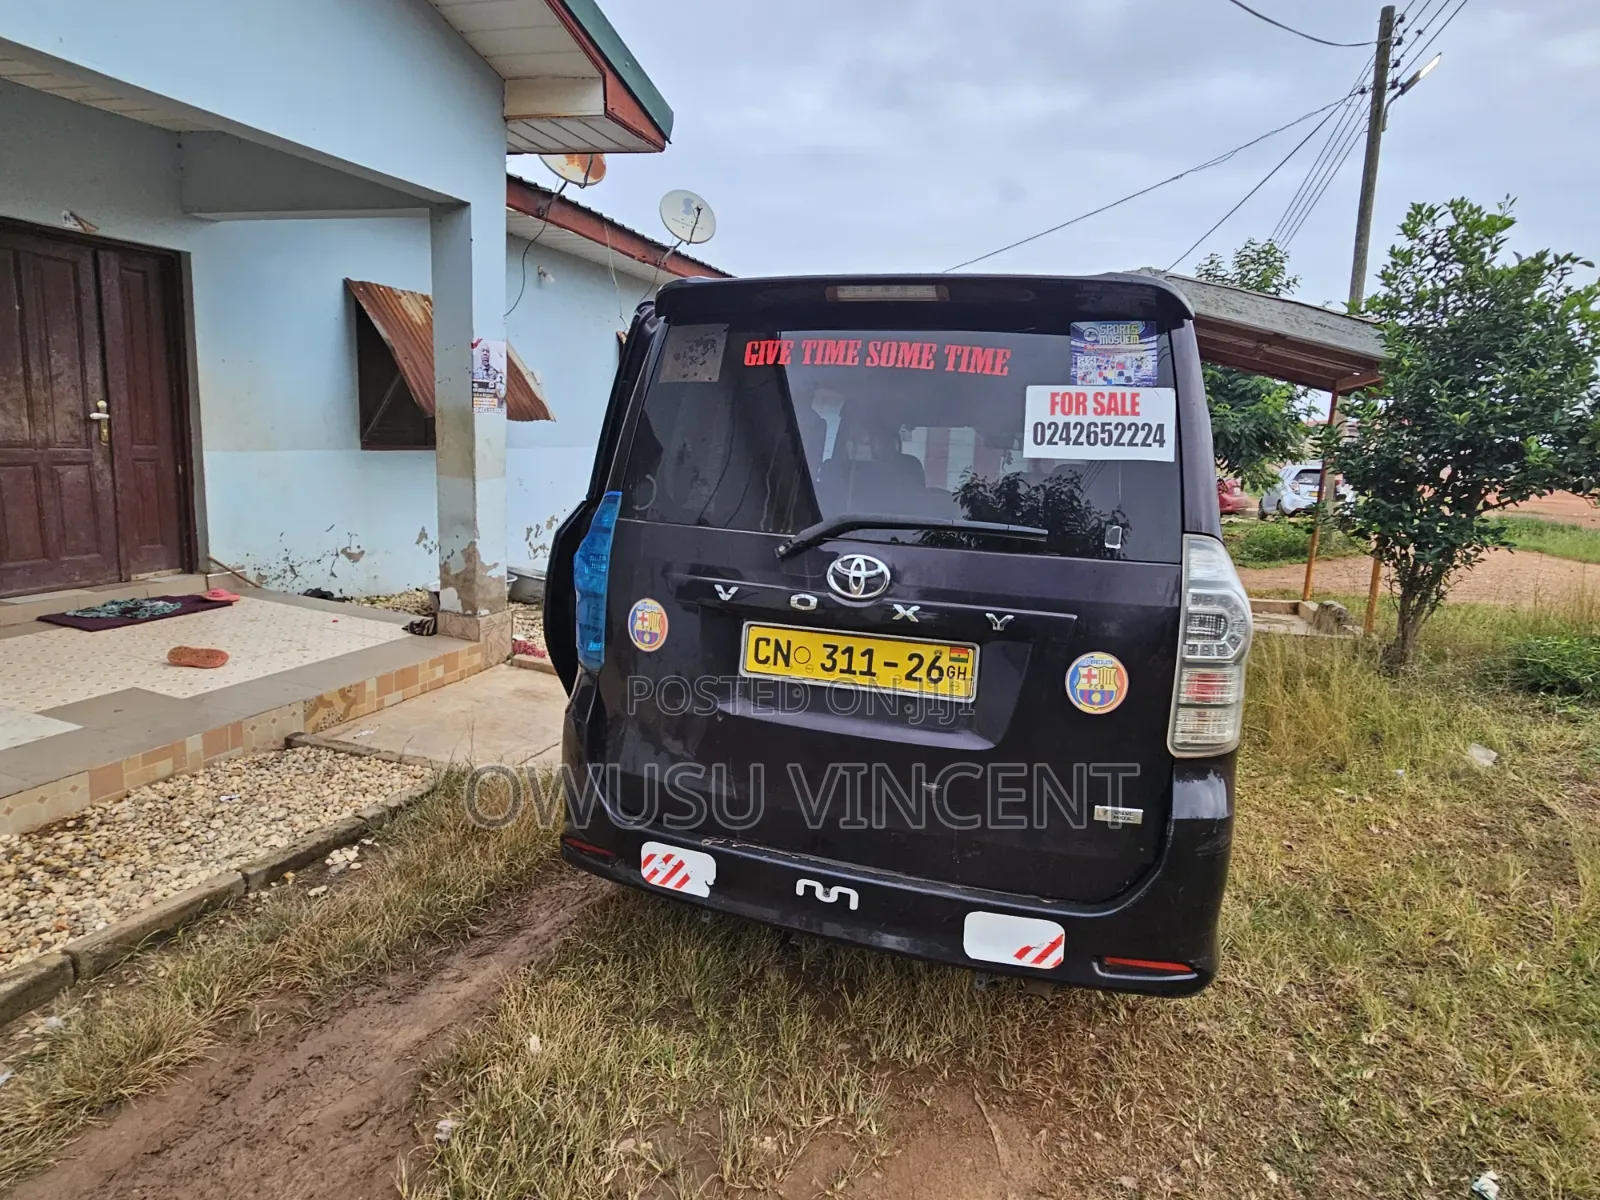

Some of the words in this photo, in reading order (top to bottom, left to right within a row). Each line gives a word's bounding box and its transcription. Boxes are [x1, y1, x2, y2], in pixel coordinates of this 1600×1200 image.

[1100, 324, 1138, 335] SPORTS
[743, 340, 795, 366] GIVE
[801, 339, 862, 366] TIME
[865, 340, 937, 370] SOME
[944, 344, 1011, 376] TIME
[1050, 391, 1088, 416] FOR
[1092, 391, 1140, 417] SALE
[1032, 421, 1165, 448] 0242652224
[714, 584, 1015, 631] VOXY
[753, 636, 792, 668] CN
[946, 665, 967, 681] GH
